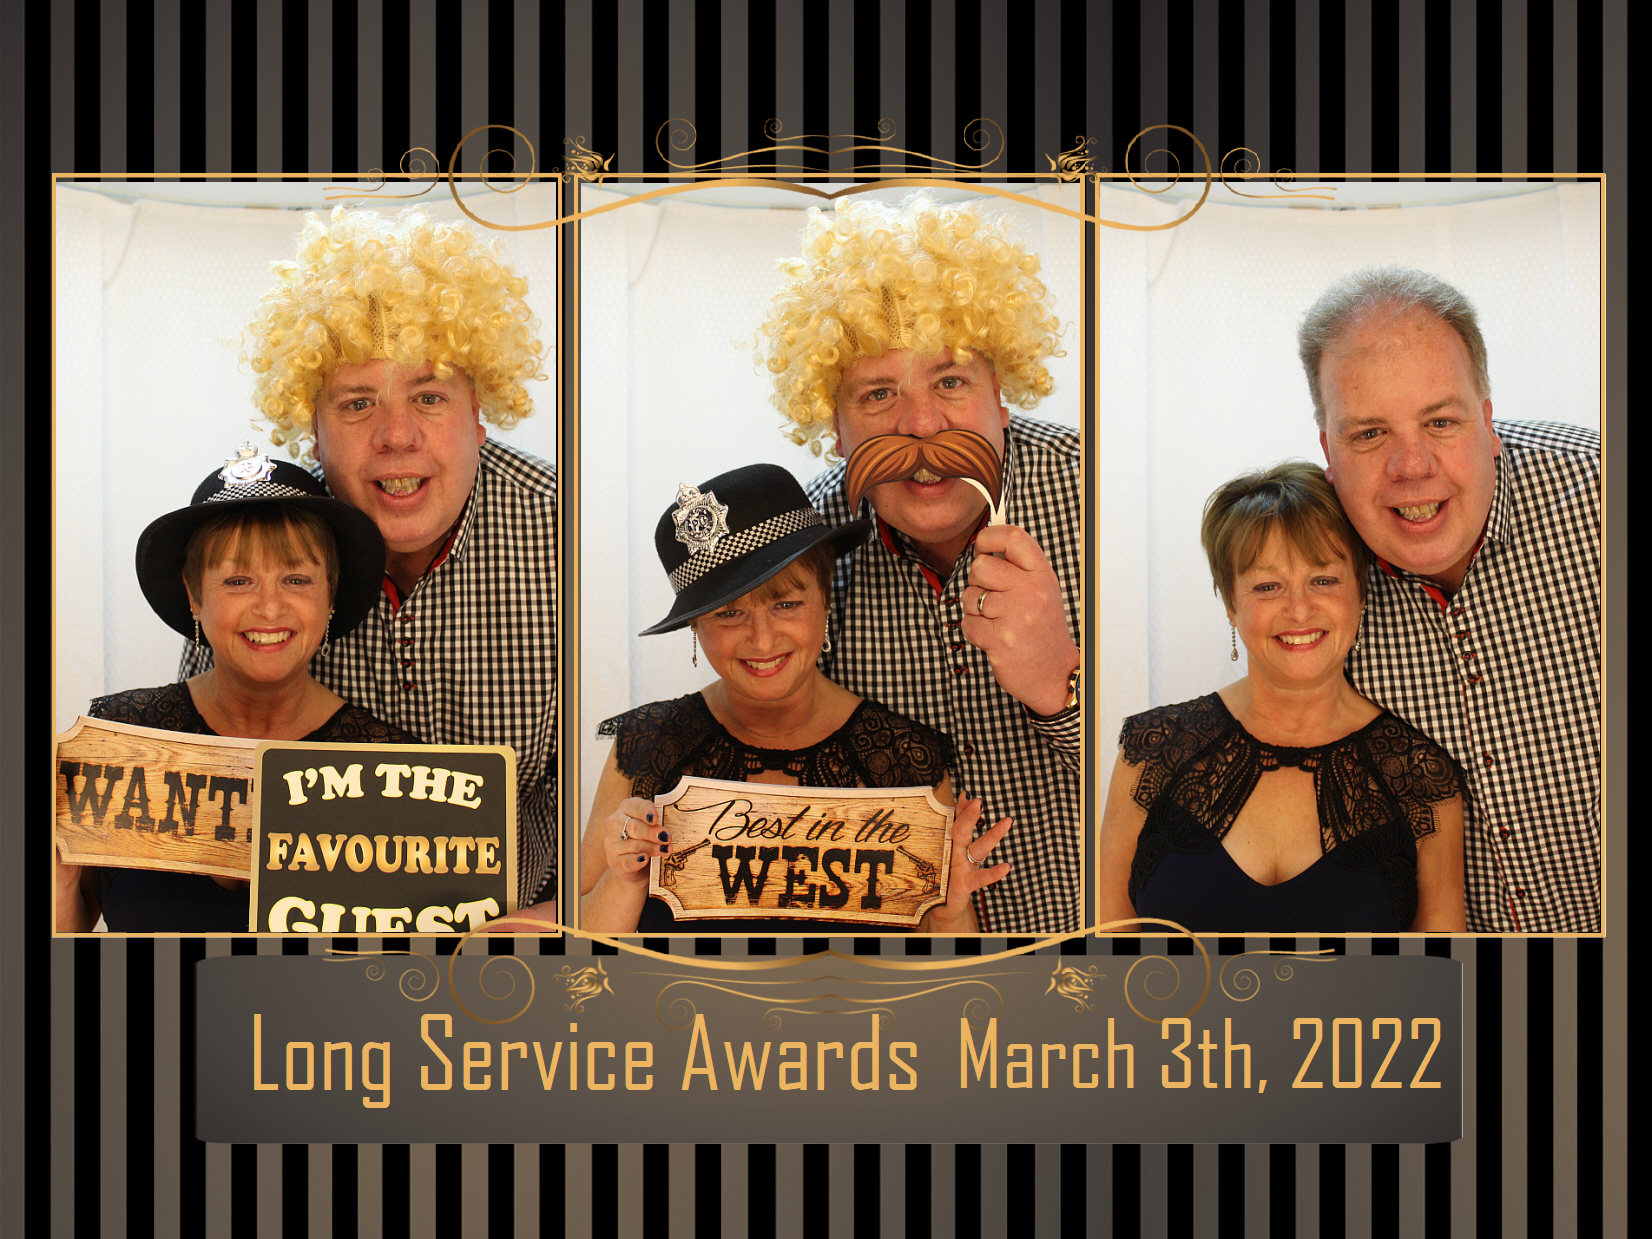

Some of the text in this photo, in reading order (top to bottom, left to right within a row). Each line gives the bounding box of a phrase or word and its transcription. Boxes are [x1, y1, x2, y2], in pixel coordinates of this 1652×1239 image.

[60, 761, 254, 843] WANT
[283, 763, 485, 809] I'M THE
[673, 799, 911, 844] Best in the
[266, 832, 502, 875] FAVOURITE
[711, 845, 895, 910] WEST
